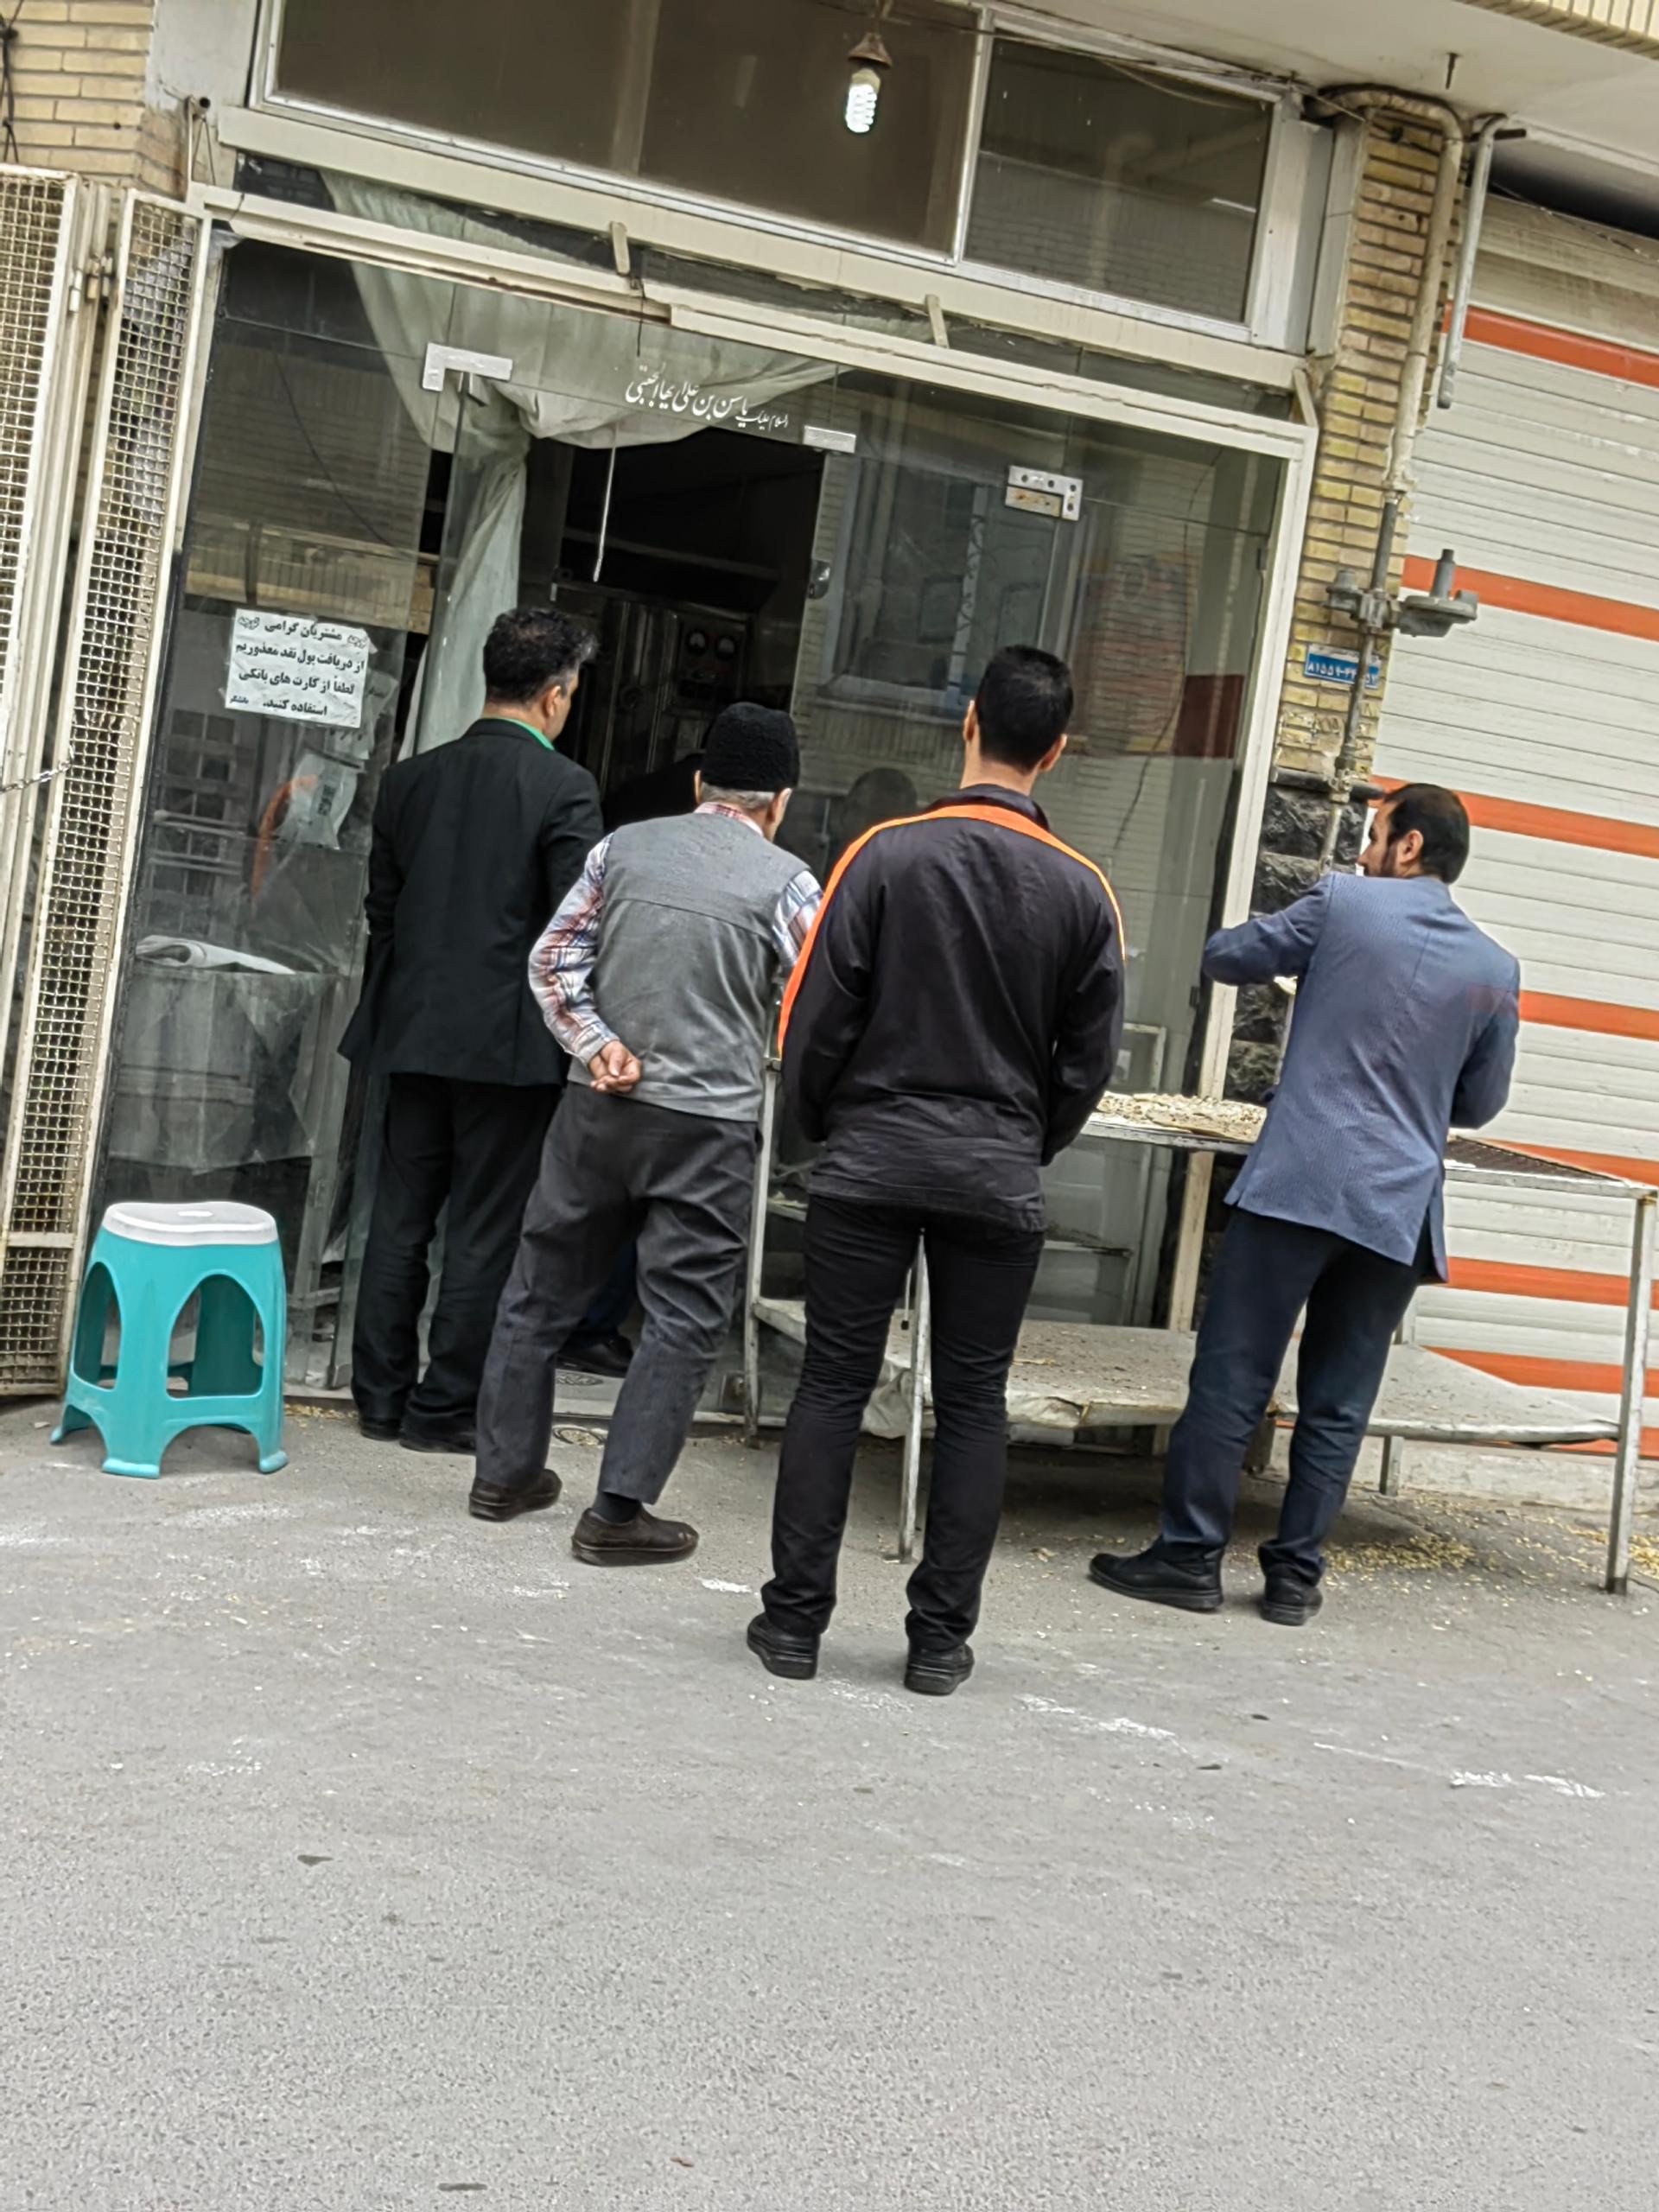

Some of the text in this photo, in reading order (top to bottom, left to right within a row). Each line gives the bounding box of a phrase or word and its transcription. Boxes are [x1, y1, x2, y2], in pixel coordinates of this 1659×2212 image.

[692, 394, 715, 420] بن
[264, 620, 299, 635] گرامی
[301, 624, 342, 641] مشتریان
[236, 642, 365, 673] از دریافت پول نقد معذوریم
[238, 669, 268, 683] بانکی
[270, 672, 290, 685] های
[293, 677, 319, 690] کارت
[320, 680, 330, 693] از
[291, 702, 327, 715] استفاده
